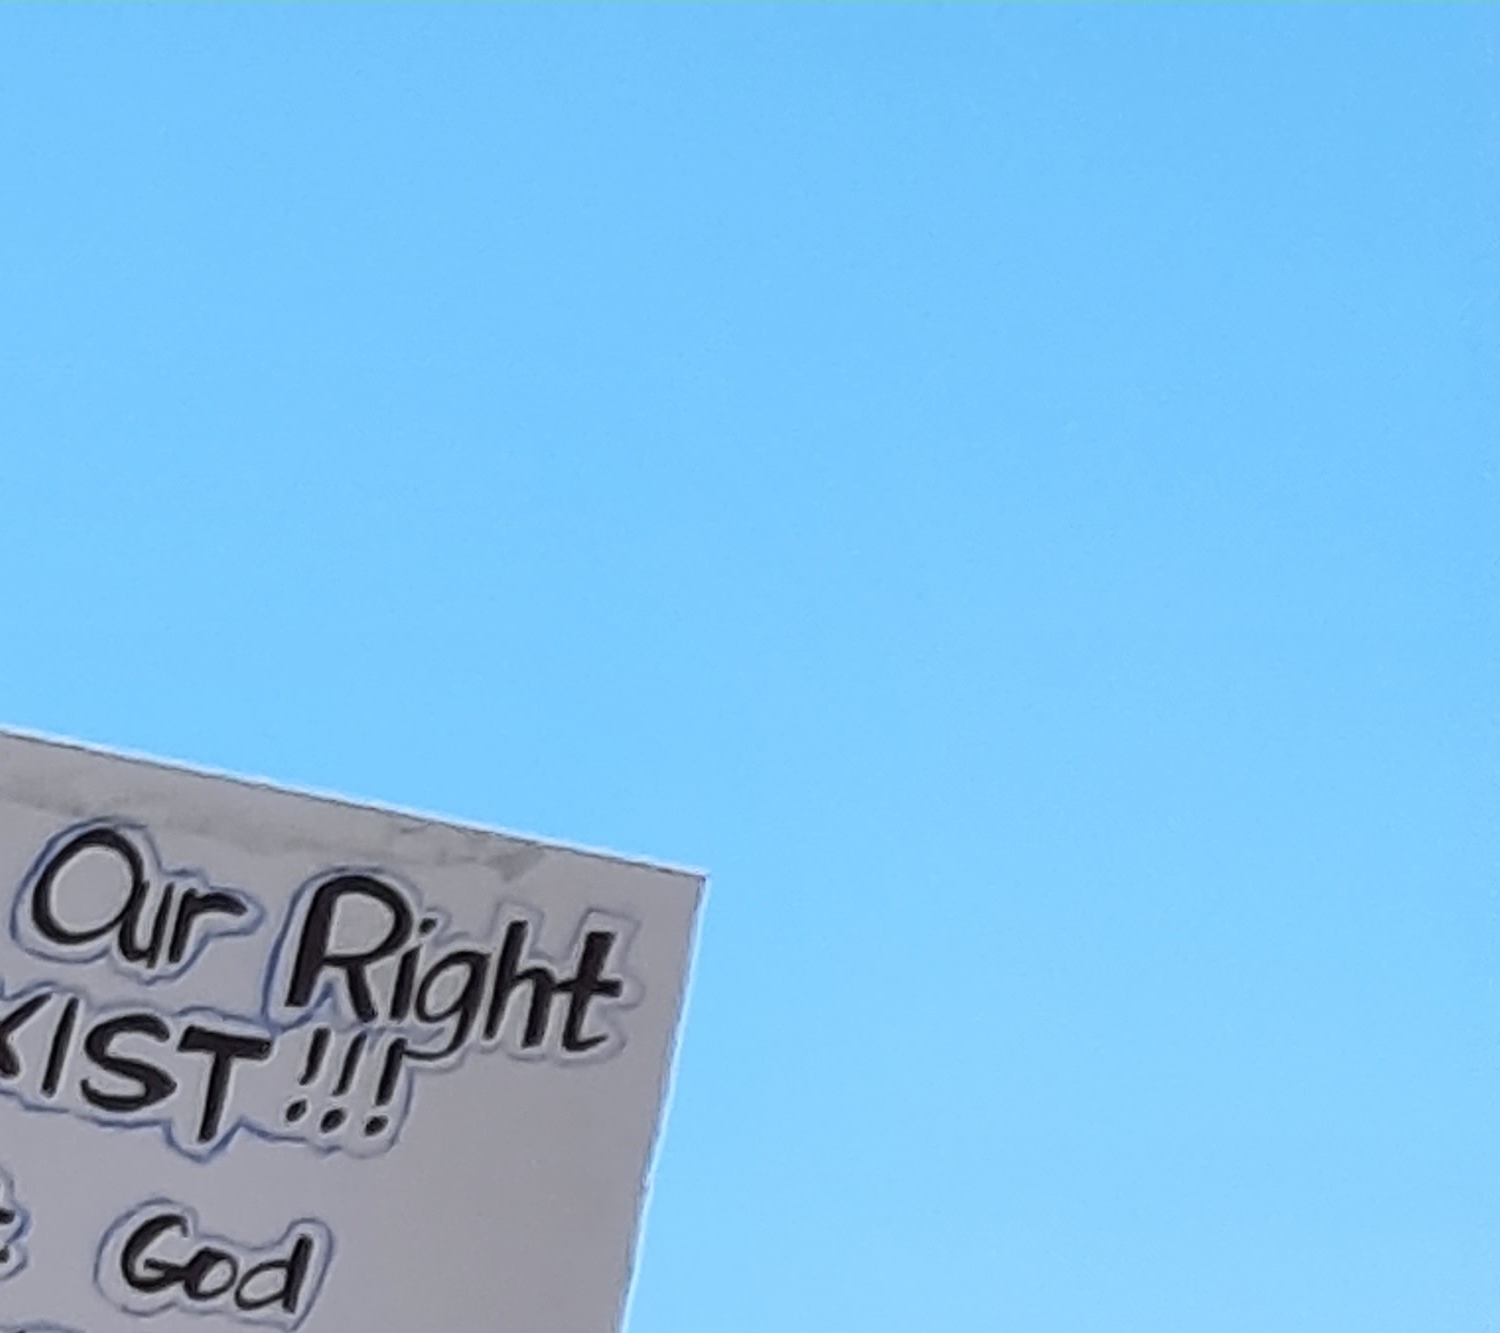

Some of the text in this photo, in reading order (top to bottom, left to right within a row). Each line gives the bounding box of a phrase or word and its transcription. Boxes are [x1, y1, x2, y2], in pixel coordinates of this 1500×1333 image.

[30, 826, 248, 970] Our
[283, 873, 622, 1060] Right
[119, 1213, 314, 1314] God
